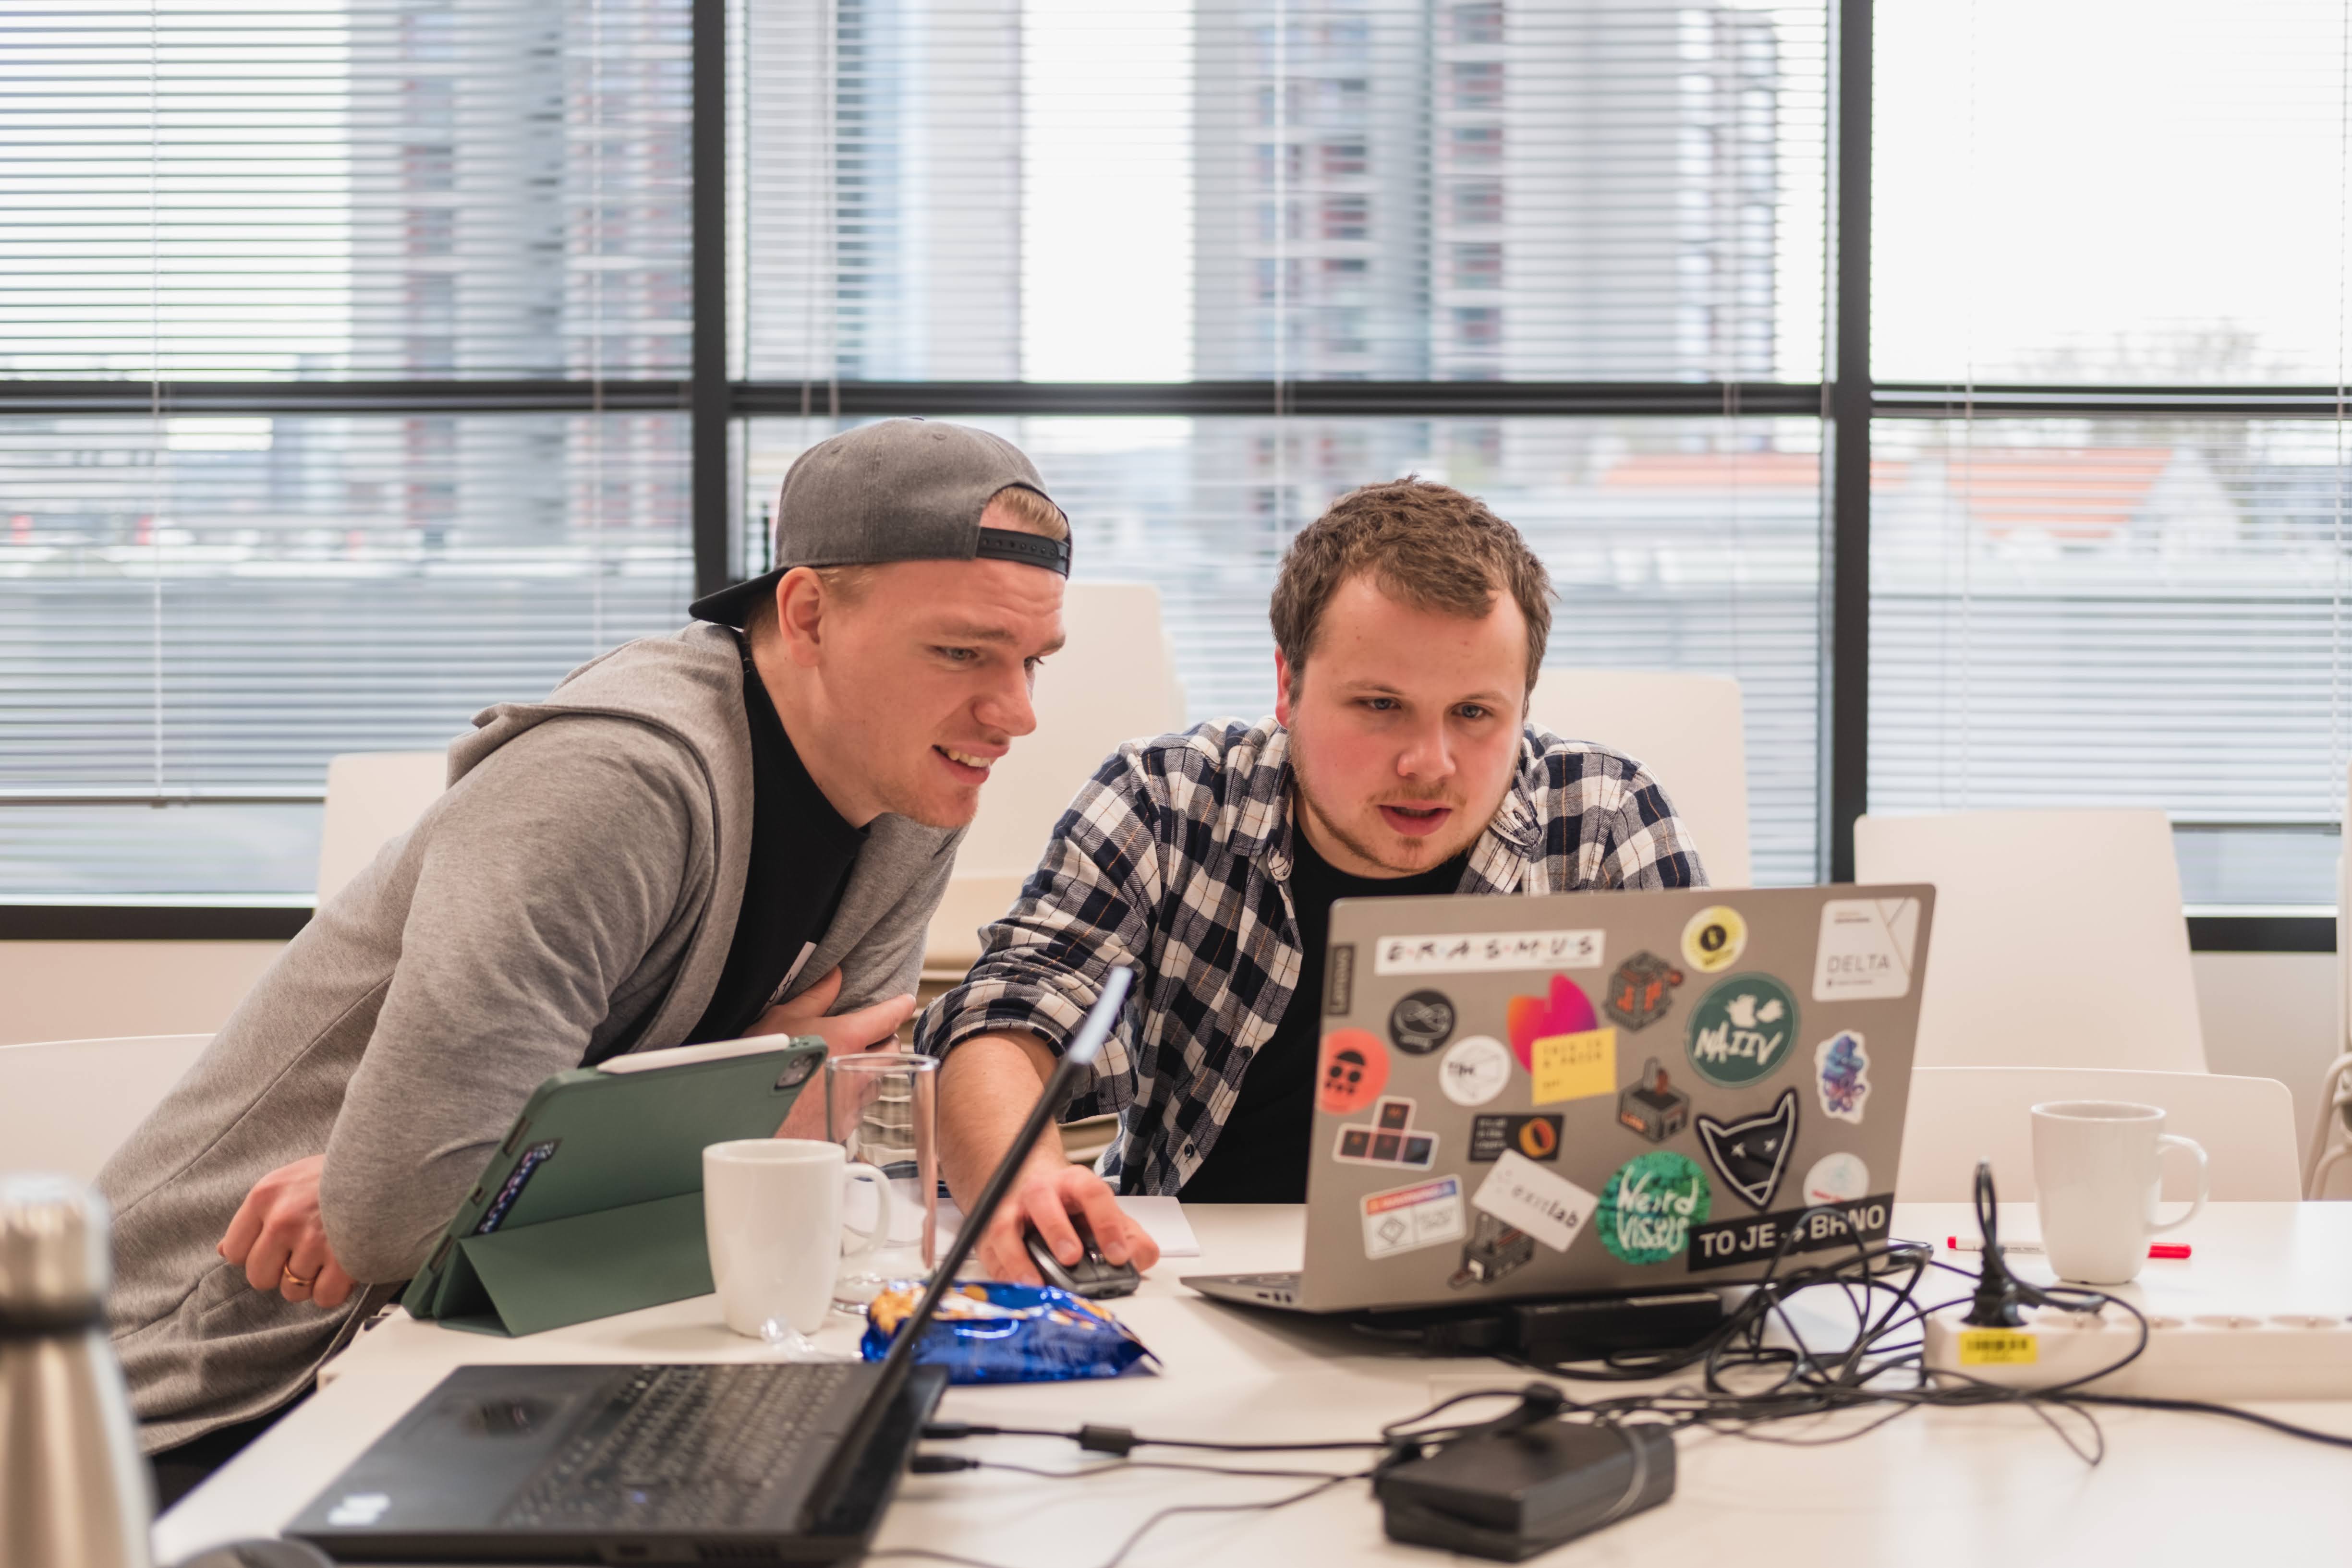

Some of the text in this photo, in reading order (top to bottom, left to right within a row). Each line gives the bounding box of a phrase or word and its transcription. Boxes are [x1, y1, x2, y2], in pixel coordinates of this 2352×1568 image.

[1827, 953, 1891, 975] DELTA
[1616, 1164, 1700, 1215] Weird
[1698, 1230, 1735, 1258] TO
[1739, 1223, 1776, 1251] JE
